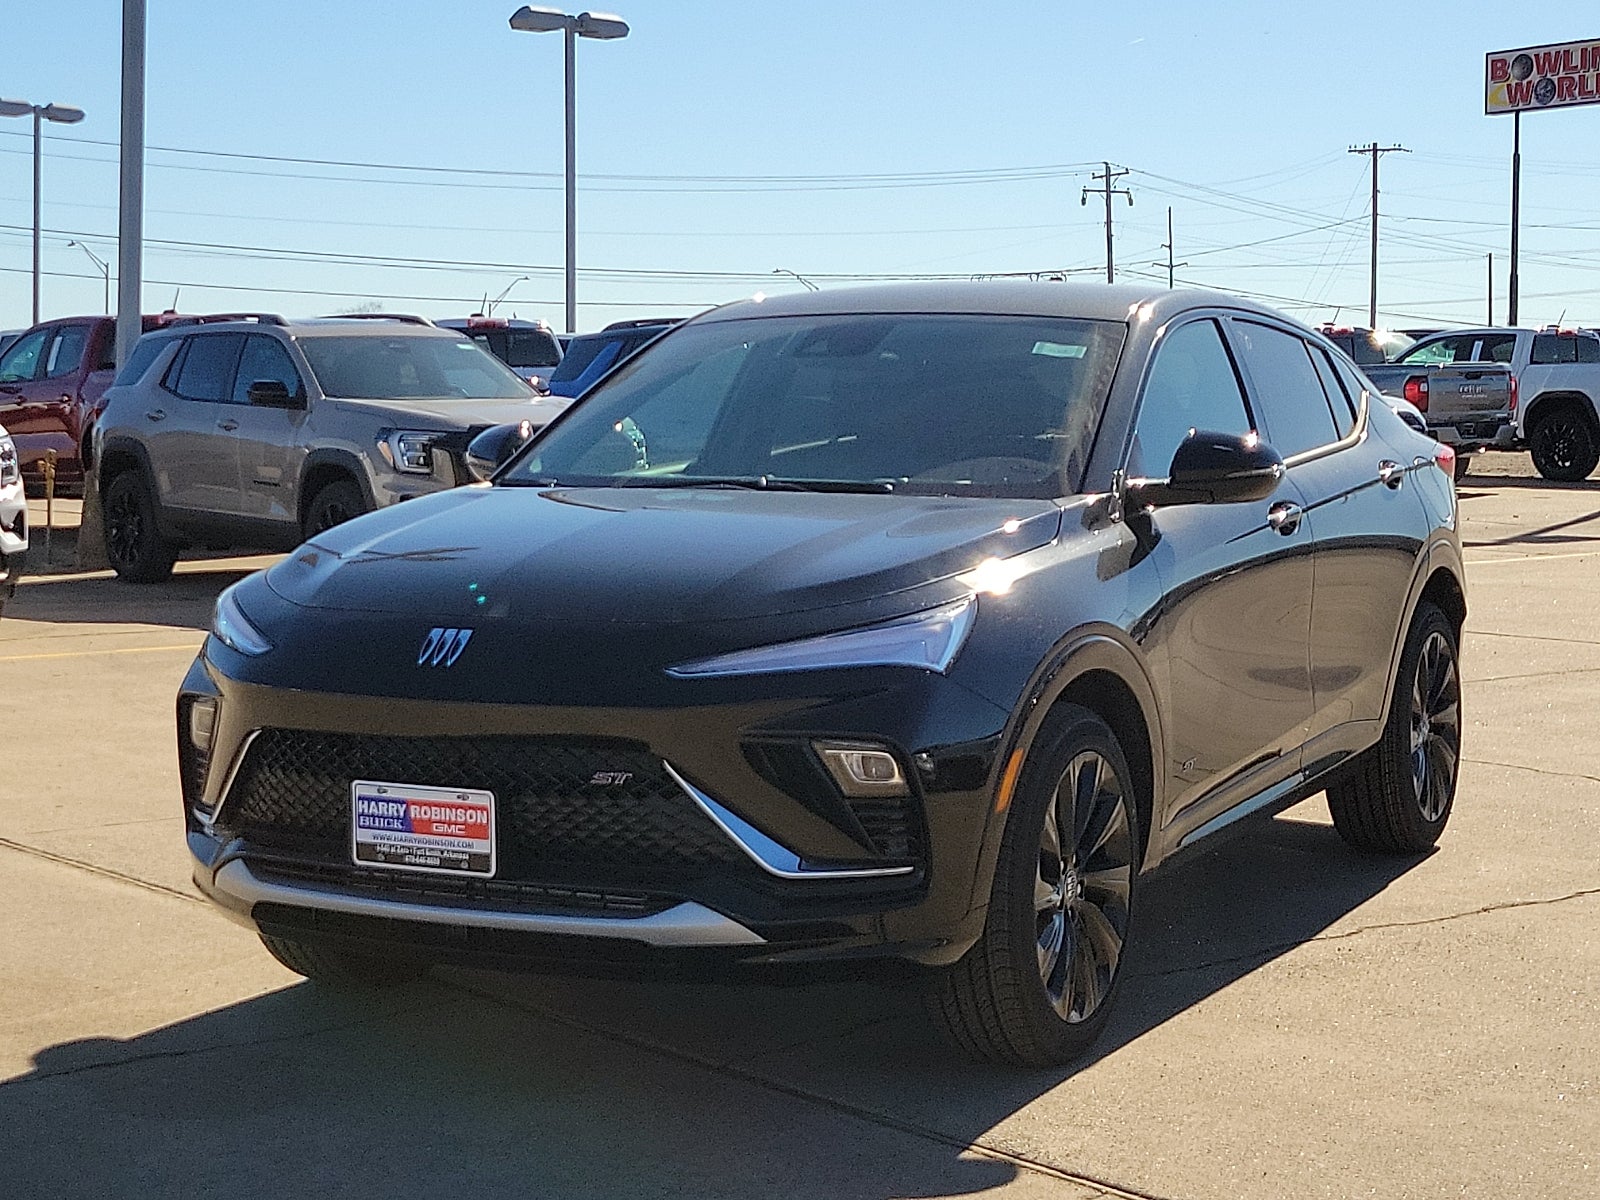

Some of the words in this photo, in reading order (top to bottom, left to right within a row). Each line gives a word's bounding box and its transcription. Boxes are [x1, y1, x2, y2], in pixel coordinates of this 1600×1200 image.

[1505, 73, 1600, 106] WORL
[590, 771, 633, 784] ST
[358, 799, 407, 819] HARRY
[410, 804, 488, 824] ROBINSON
[359, 815, 404, 829] BUICK
[432, 822, 466, 834] GMC
[372, 833, 475, 849] WWW.HARRYROBINSON.COM
